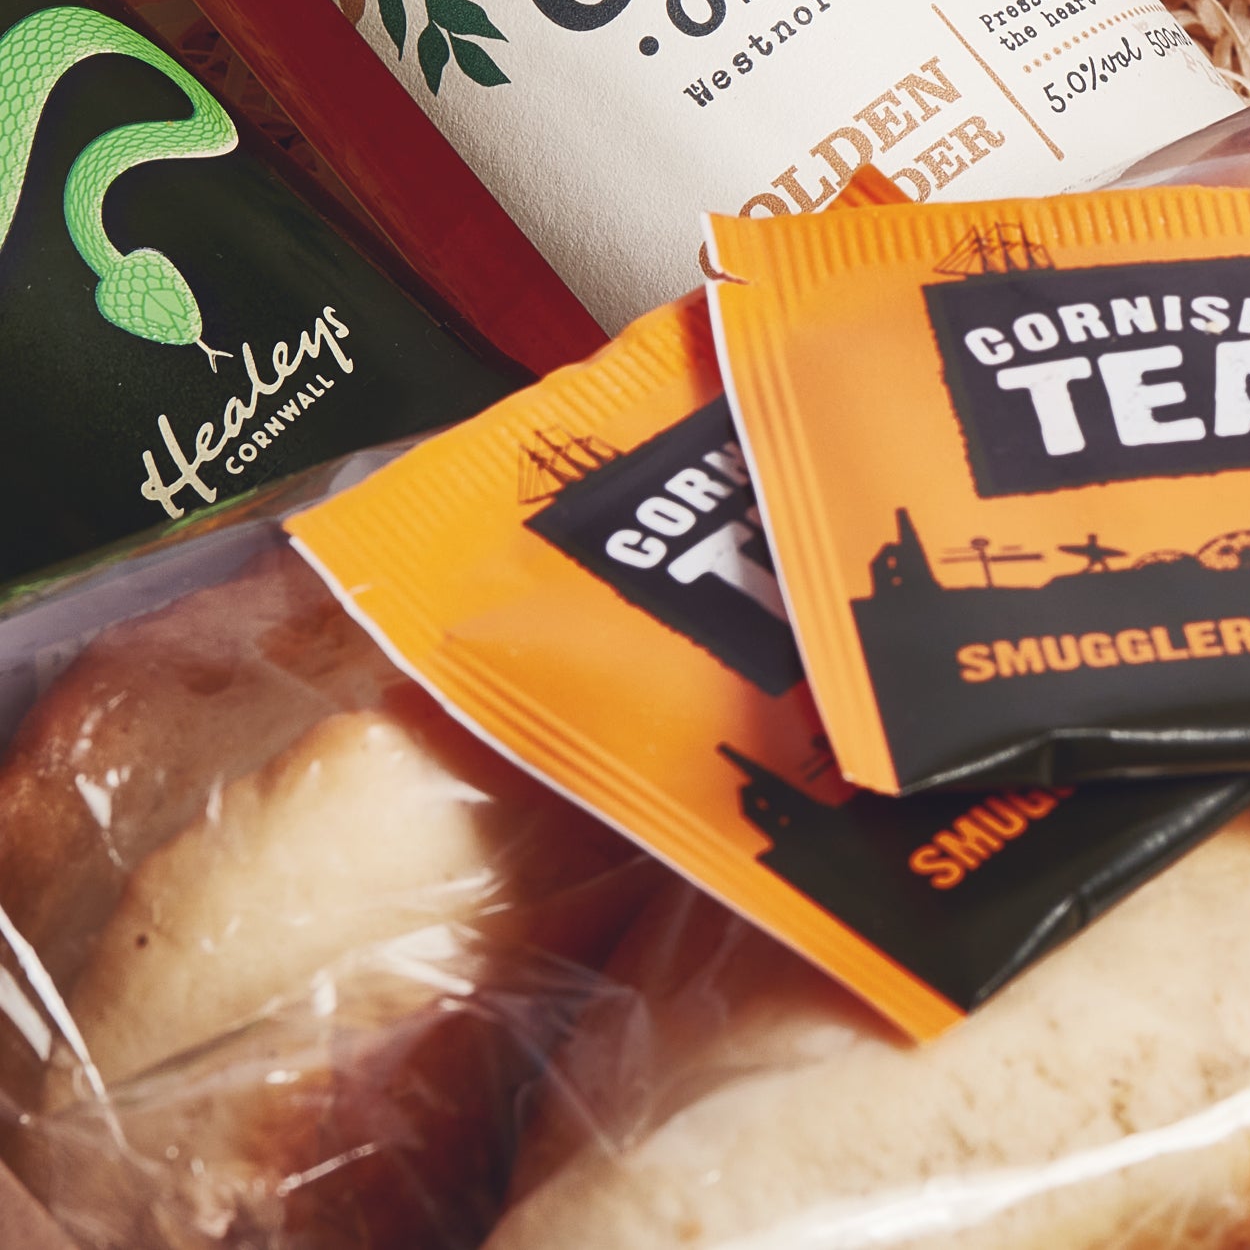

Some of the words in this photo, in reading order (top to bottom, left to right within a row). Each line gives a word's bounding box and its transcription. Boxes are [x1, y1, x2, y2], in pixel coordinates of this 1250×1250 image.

[1000, 24, 1038, 51] the
[140, 306, 353, 520] Healeys
[225, 371, 334, 475] CORNWALL
